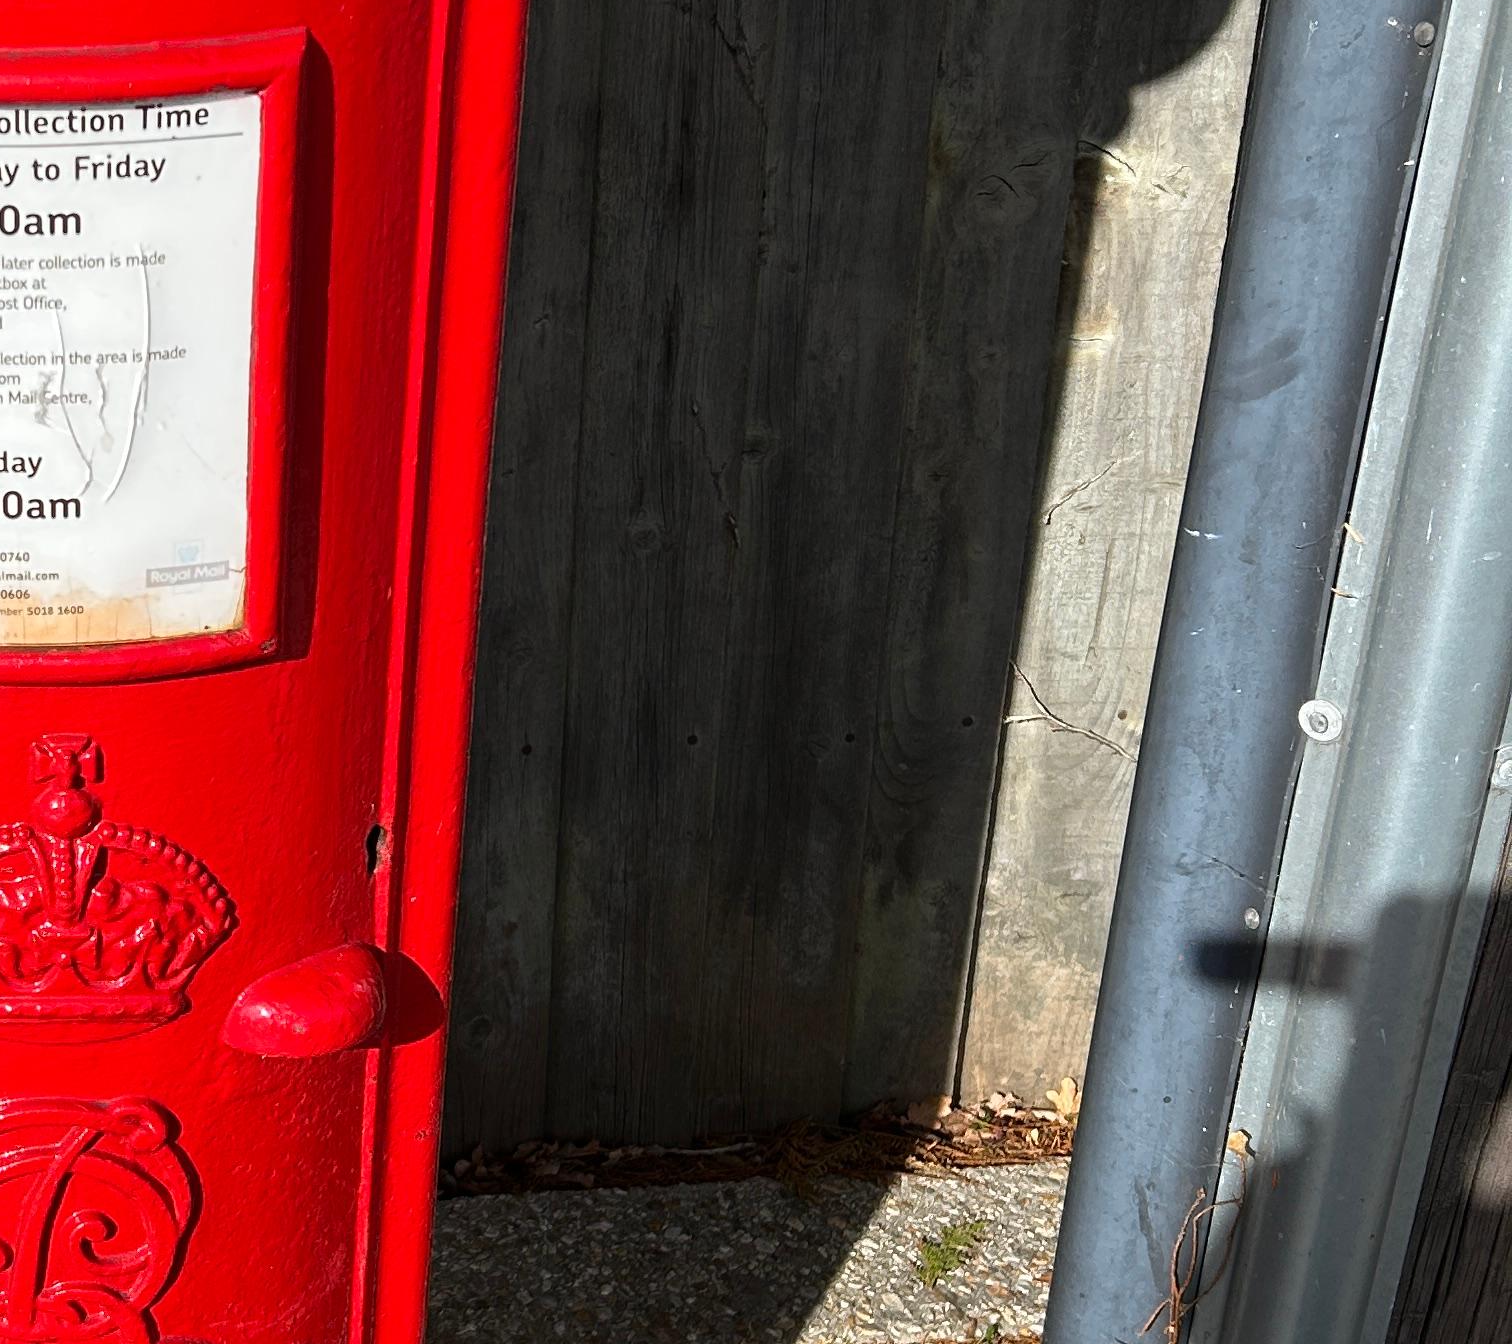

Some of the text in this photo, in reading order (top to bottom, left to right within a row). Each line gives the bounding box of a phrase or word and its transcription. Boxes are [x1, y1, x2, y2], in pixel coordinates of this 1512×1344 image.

[136, 104, 209, 129] Time
[32, 159, 60, 181] to
[75, 154, 166, 183] Friday
[1, 256, 34, 270] later
[39, 255, 105, 269] collection
[110, 252, 121, 267] is
[126, 251, 166, 267] made
[32, 278, 46, 290] at
[24, 295, 67, 311] Office,
[51, 351, 65, 365] in
[69, 350, 91, 365] the
[96, 352, 127, 364] area
[132, 349, 142, 363] is
[148, 346, 186, 362] made
[8, 390, 37, 404] Mail
[151, 567, 191, 584] Royal
